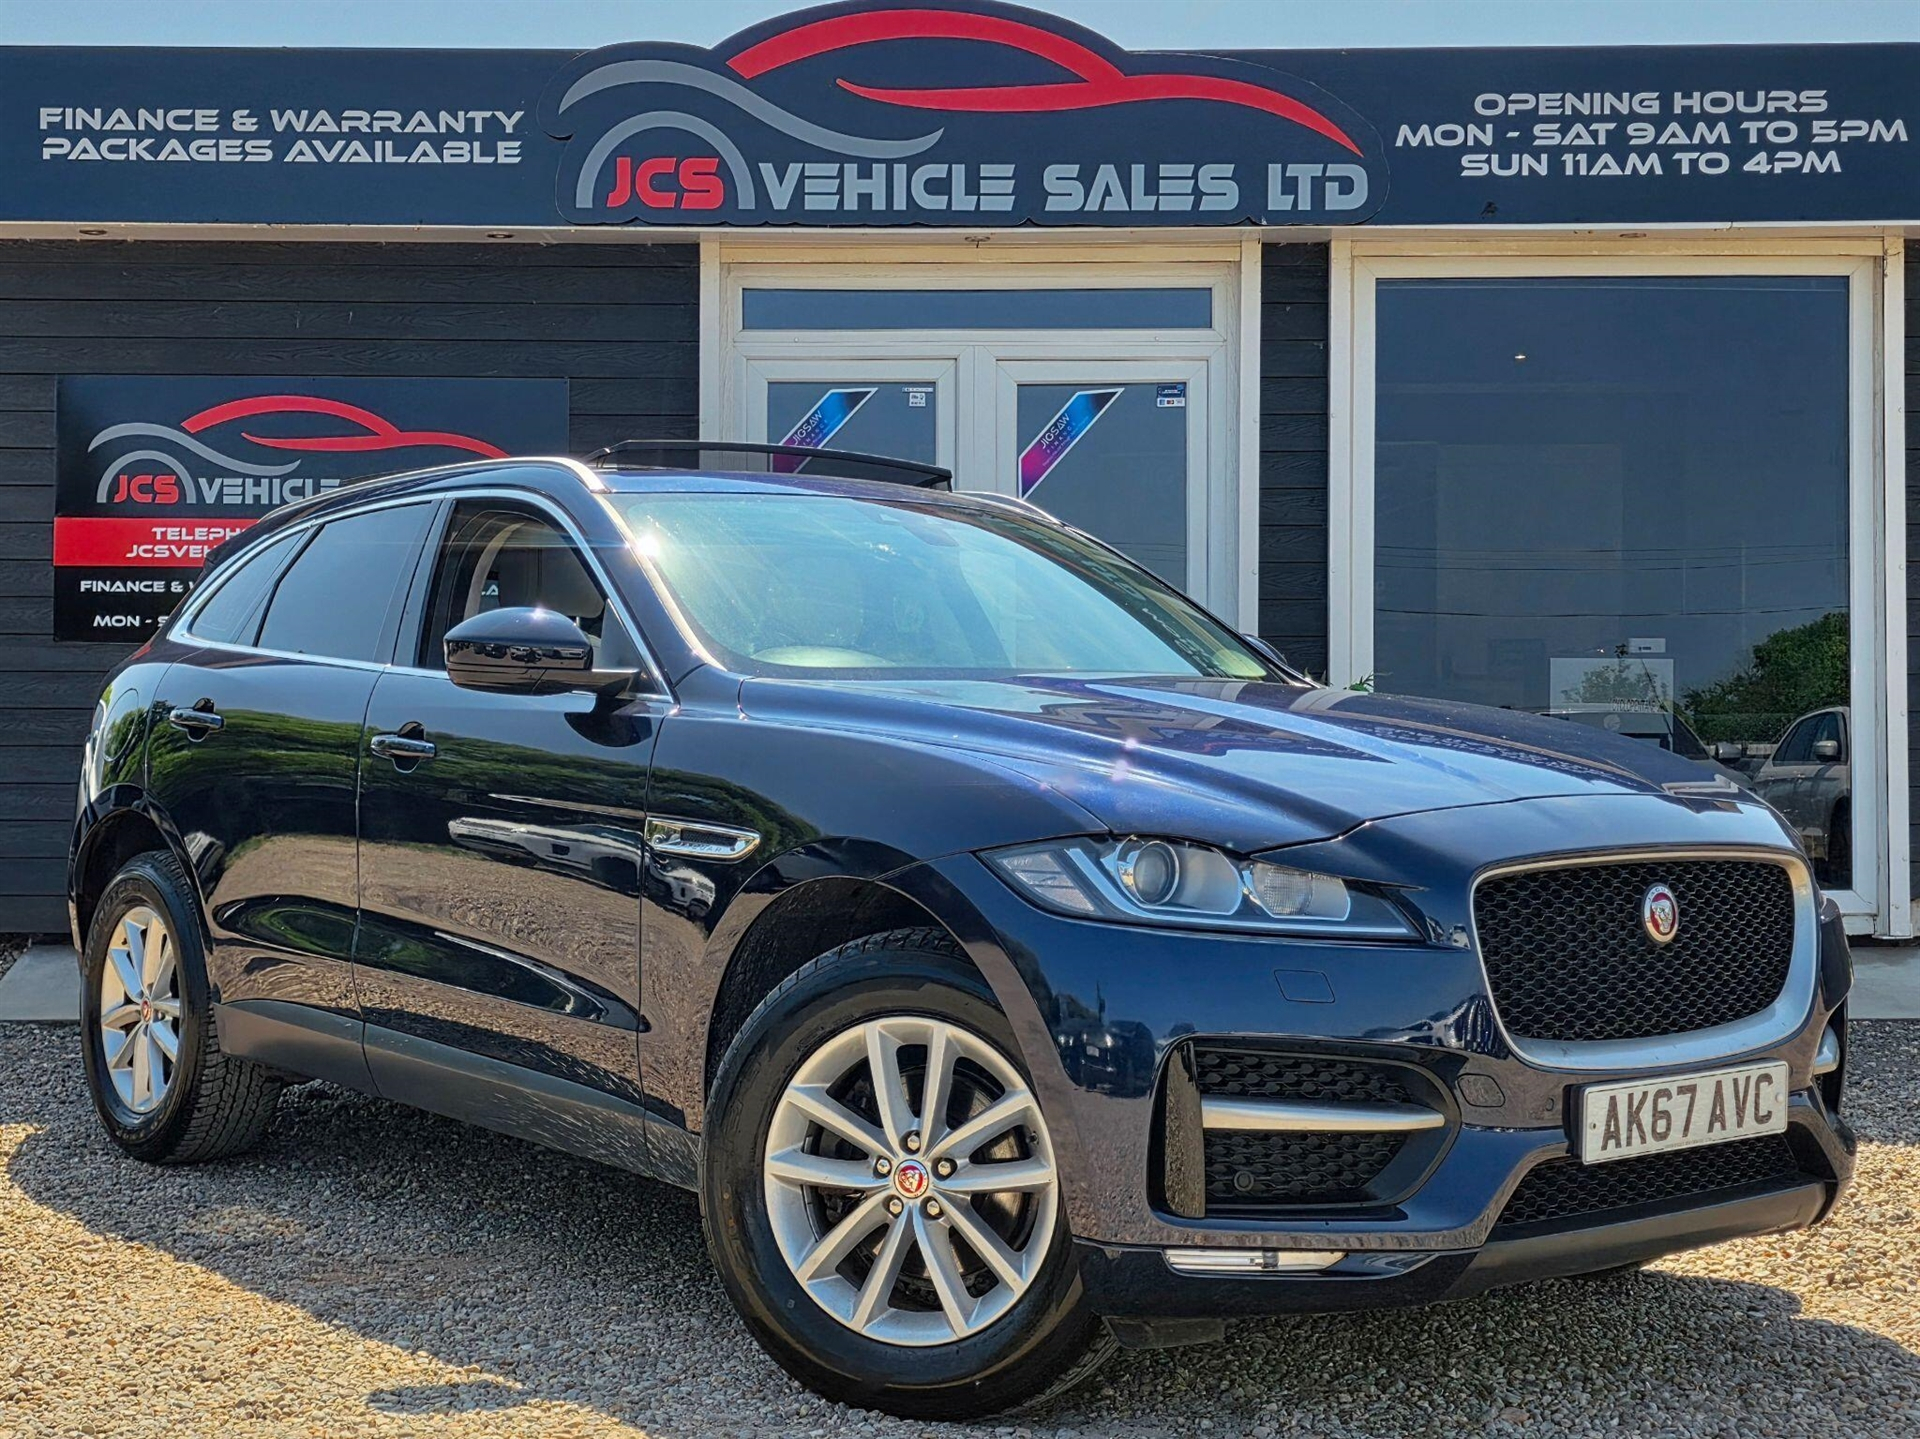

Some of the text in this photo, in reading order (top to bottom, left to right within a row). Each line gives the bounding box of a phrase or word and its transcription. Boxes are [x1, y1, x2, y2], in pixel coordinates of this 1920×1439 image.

[1474, 90, 1828, 116] OPENING HOURS
[39, 107, 525, 134] FINANCE & WARRANTY
[1395, 123, 1493, 147] MON
[1532, 122, 1617, 146] SAT
[1626, 121, 1731, 145] 9AM
[1740, 120, 1798, 144] TO
[1811, 119, 1908, 143] 5PM
[42, 137, 522, 164] PACKAGES AVAILABLE
[1460, 150, 1842, 177] SUN 11AM TO 4PM
[607, 156, 1368, 211] JCS VEHICLE SALES LTD
[792, 410, 823, 446] JIGSAW
[1040, 412, 1070, 450] JIGSAW
[112, 474, 179, 504] JCS
[151, 527, 246, 541] TELEPH
[80, 580, 166, 593] FINANCE
[170, 581, 184, 593] &
[93, 614, 140, 627] MON
[1600, 1072, 1775, 1151] AK67 AVC
